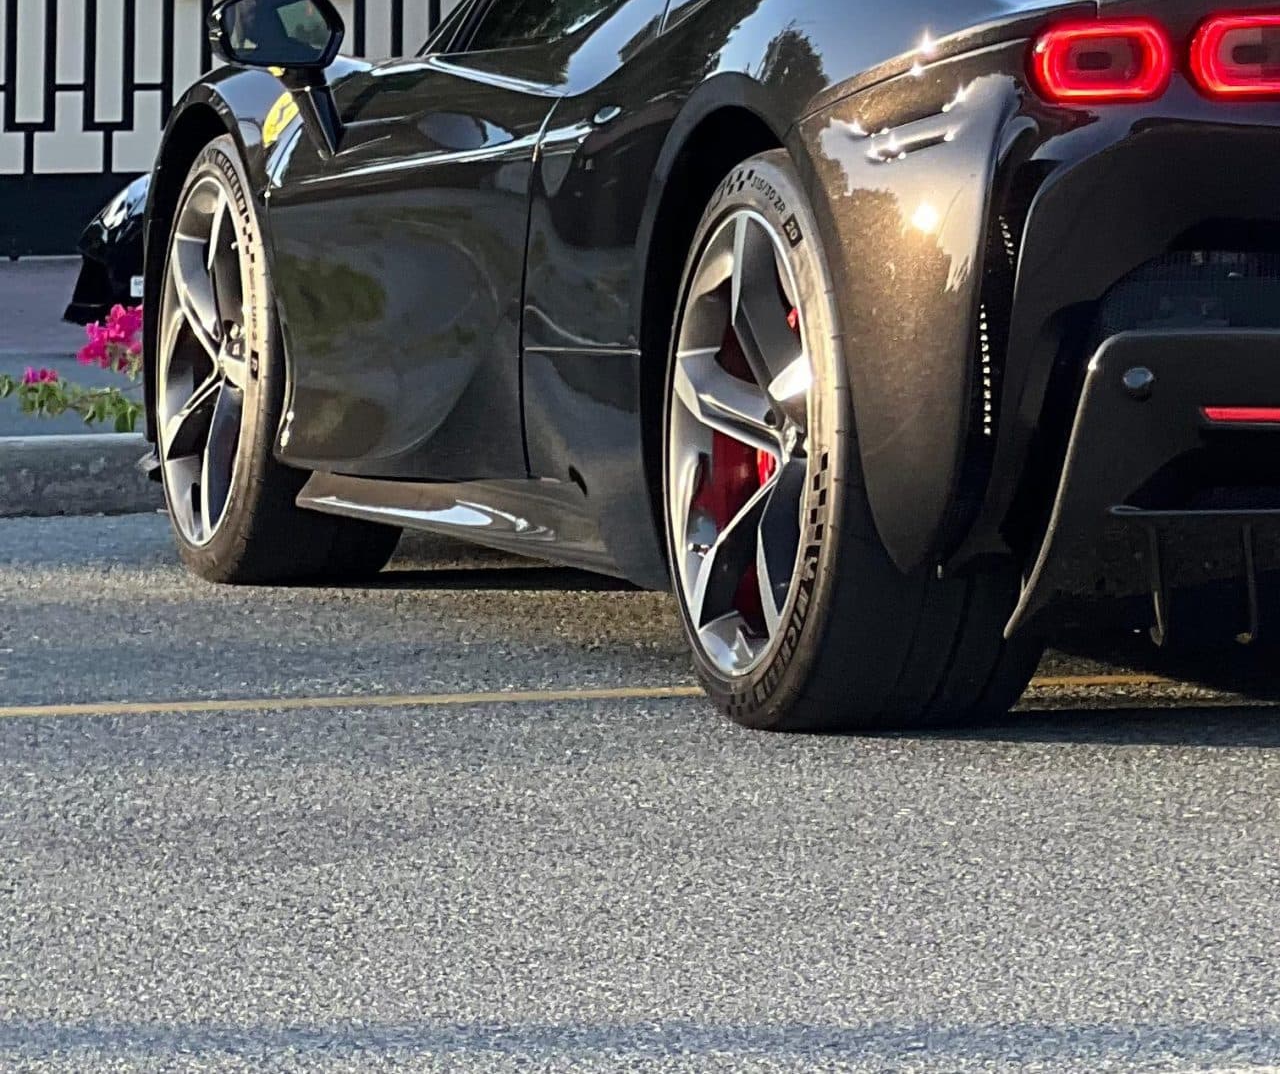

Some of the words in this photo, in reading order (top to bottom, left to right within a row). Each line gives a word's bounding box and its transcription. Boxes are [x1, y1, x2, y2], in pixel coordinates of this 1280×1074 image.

[215, 151, 247, 210] MICHELIN
[773, 195, 786, 214] ZR
[785, 220, 798, 240] 20
